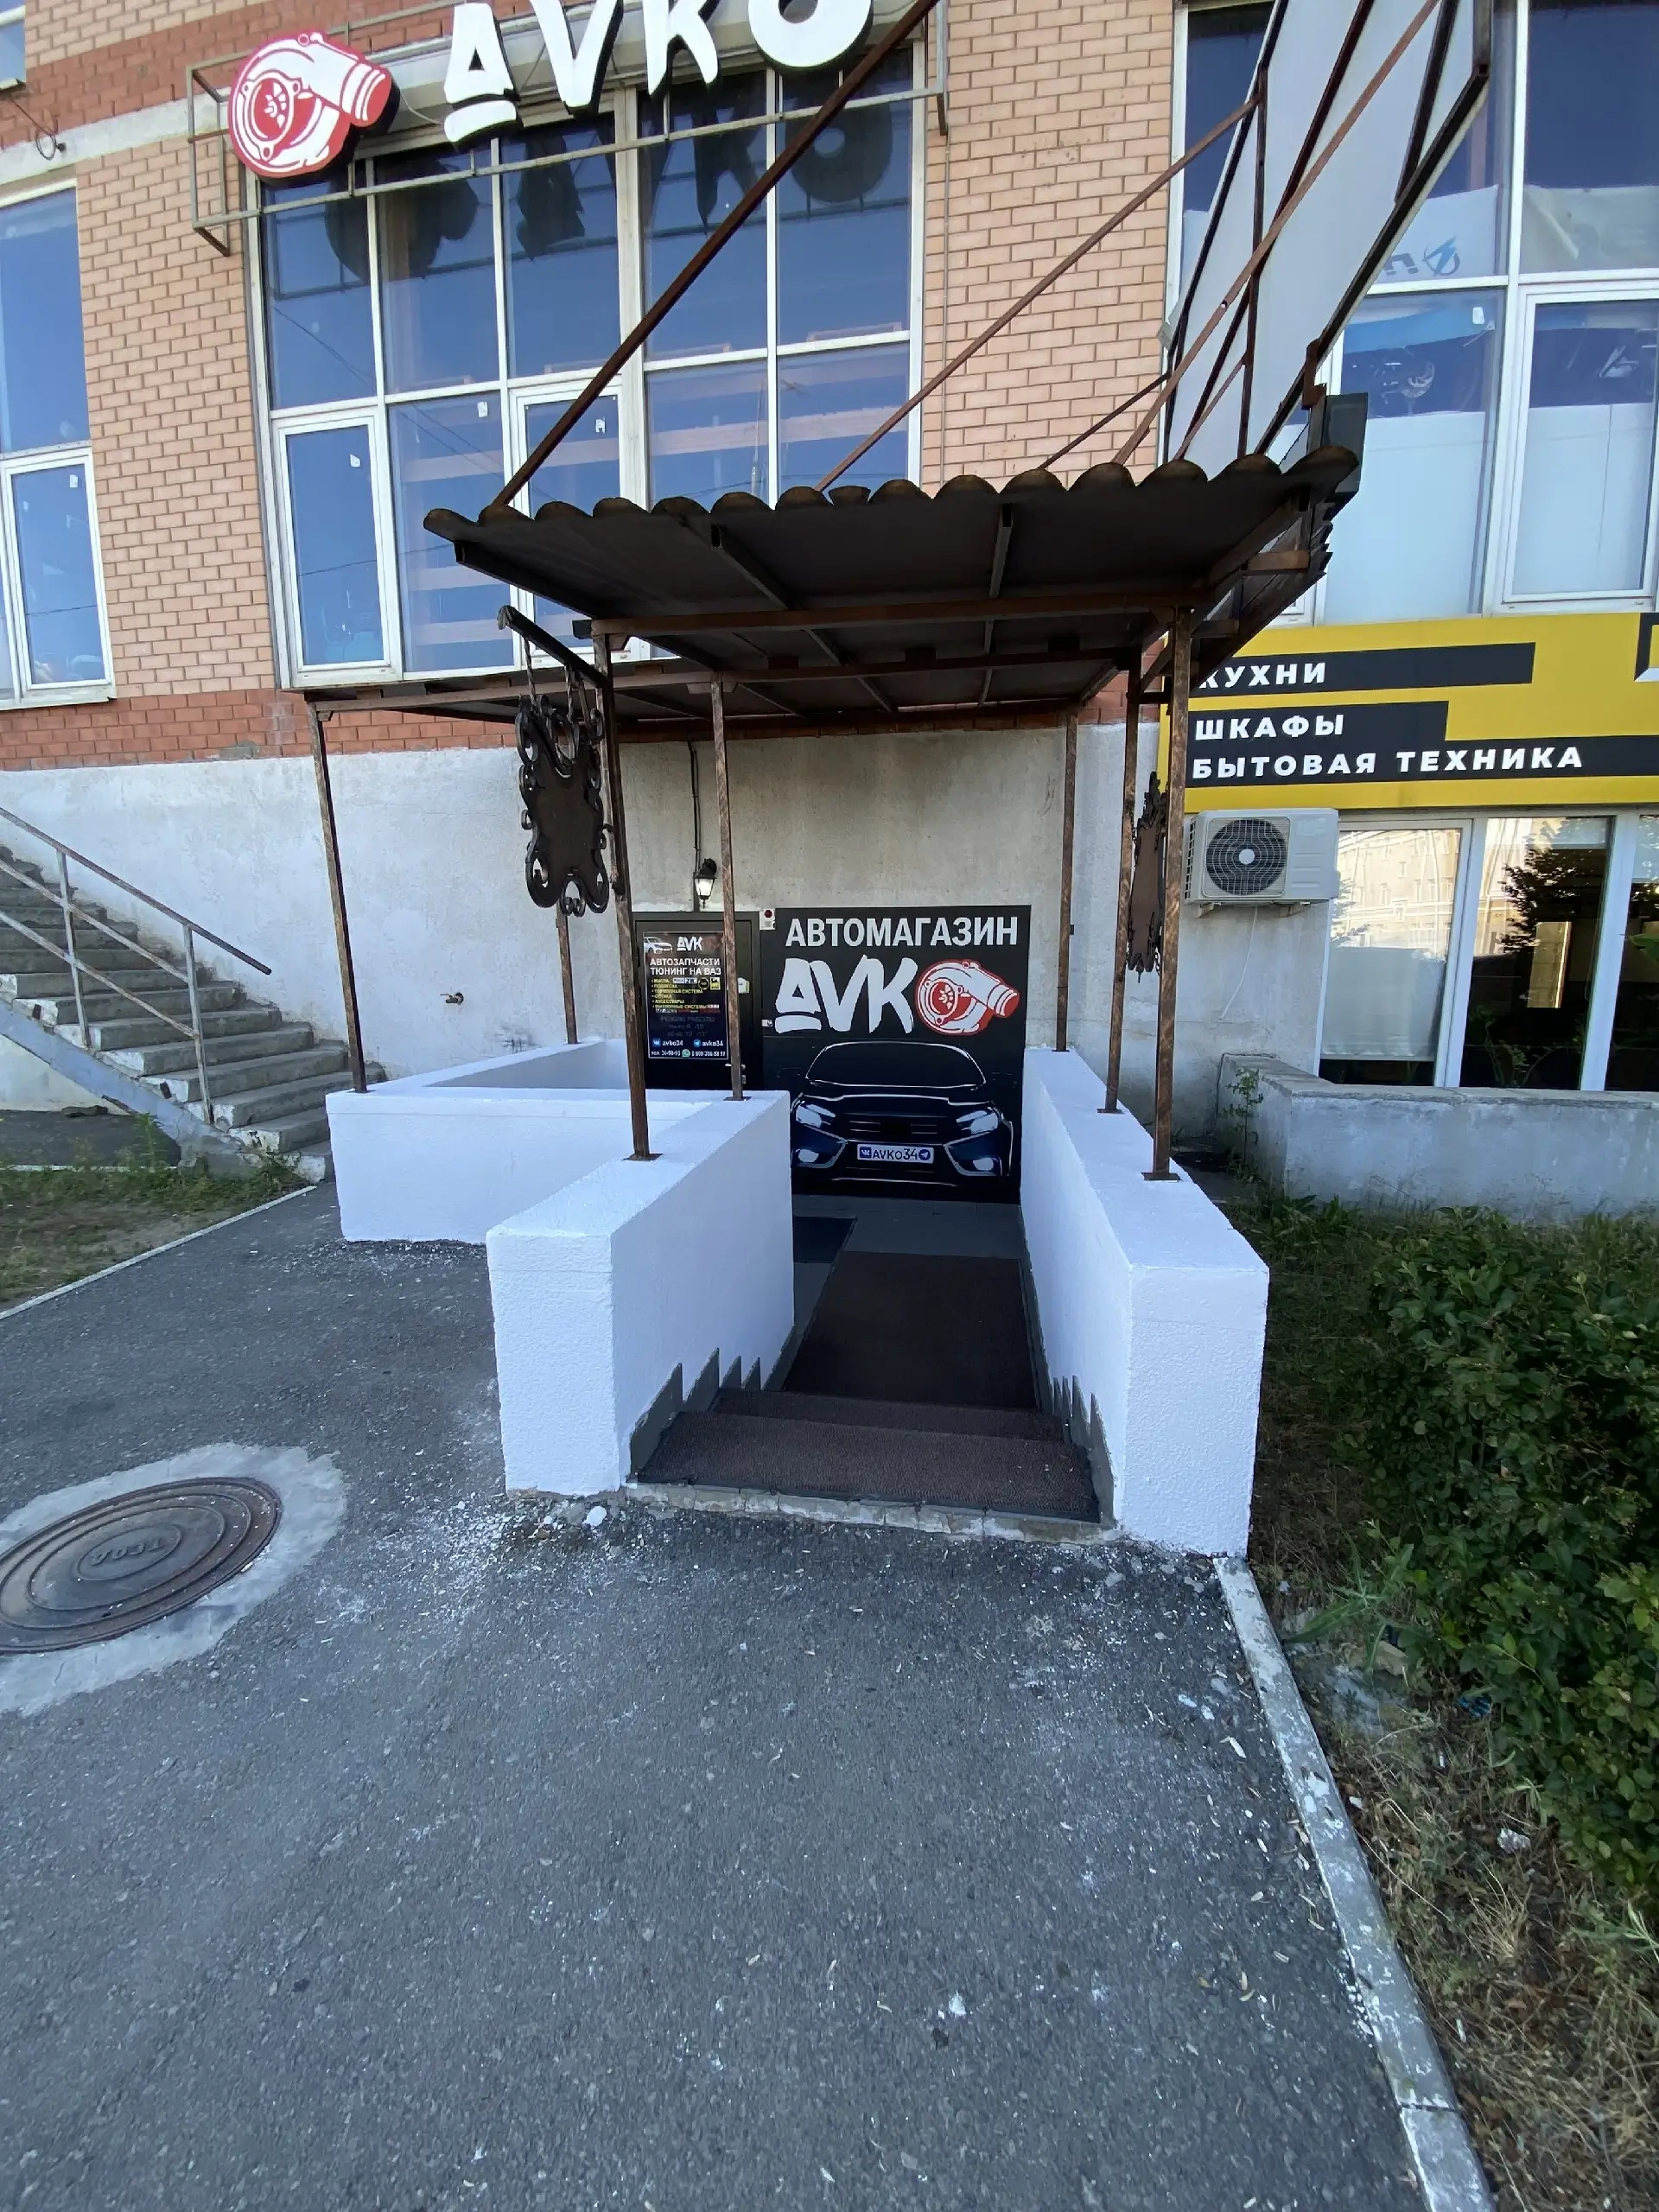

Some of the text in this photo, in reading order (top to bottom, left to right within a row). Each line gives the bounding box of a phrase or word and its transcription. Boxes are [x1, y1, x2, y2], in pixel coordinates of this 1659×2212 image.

[1195, 714, 1344, 741] ШКАФЫ
[1192, 747, 1583, 779] БЫТОВАЯ ТЕХНИКА
[785, 916, 1019, 947] АВТОМАГАЗИН
[650, 957, 721, 966] АВТОЗАПЧАСТИ
[650, 967, 721, 976] ТЮНИНГ НА ВАЗ
